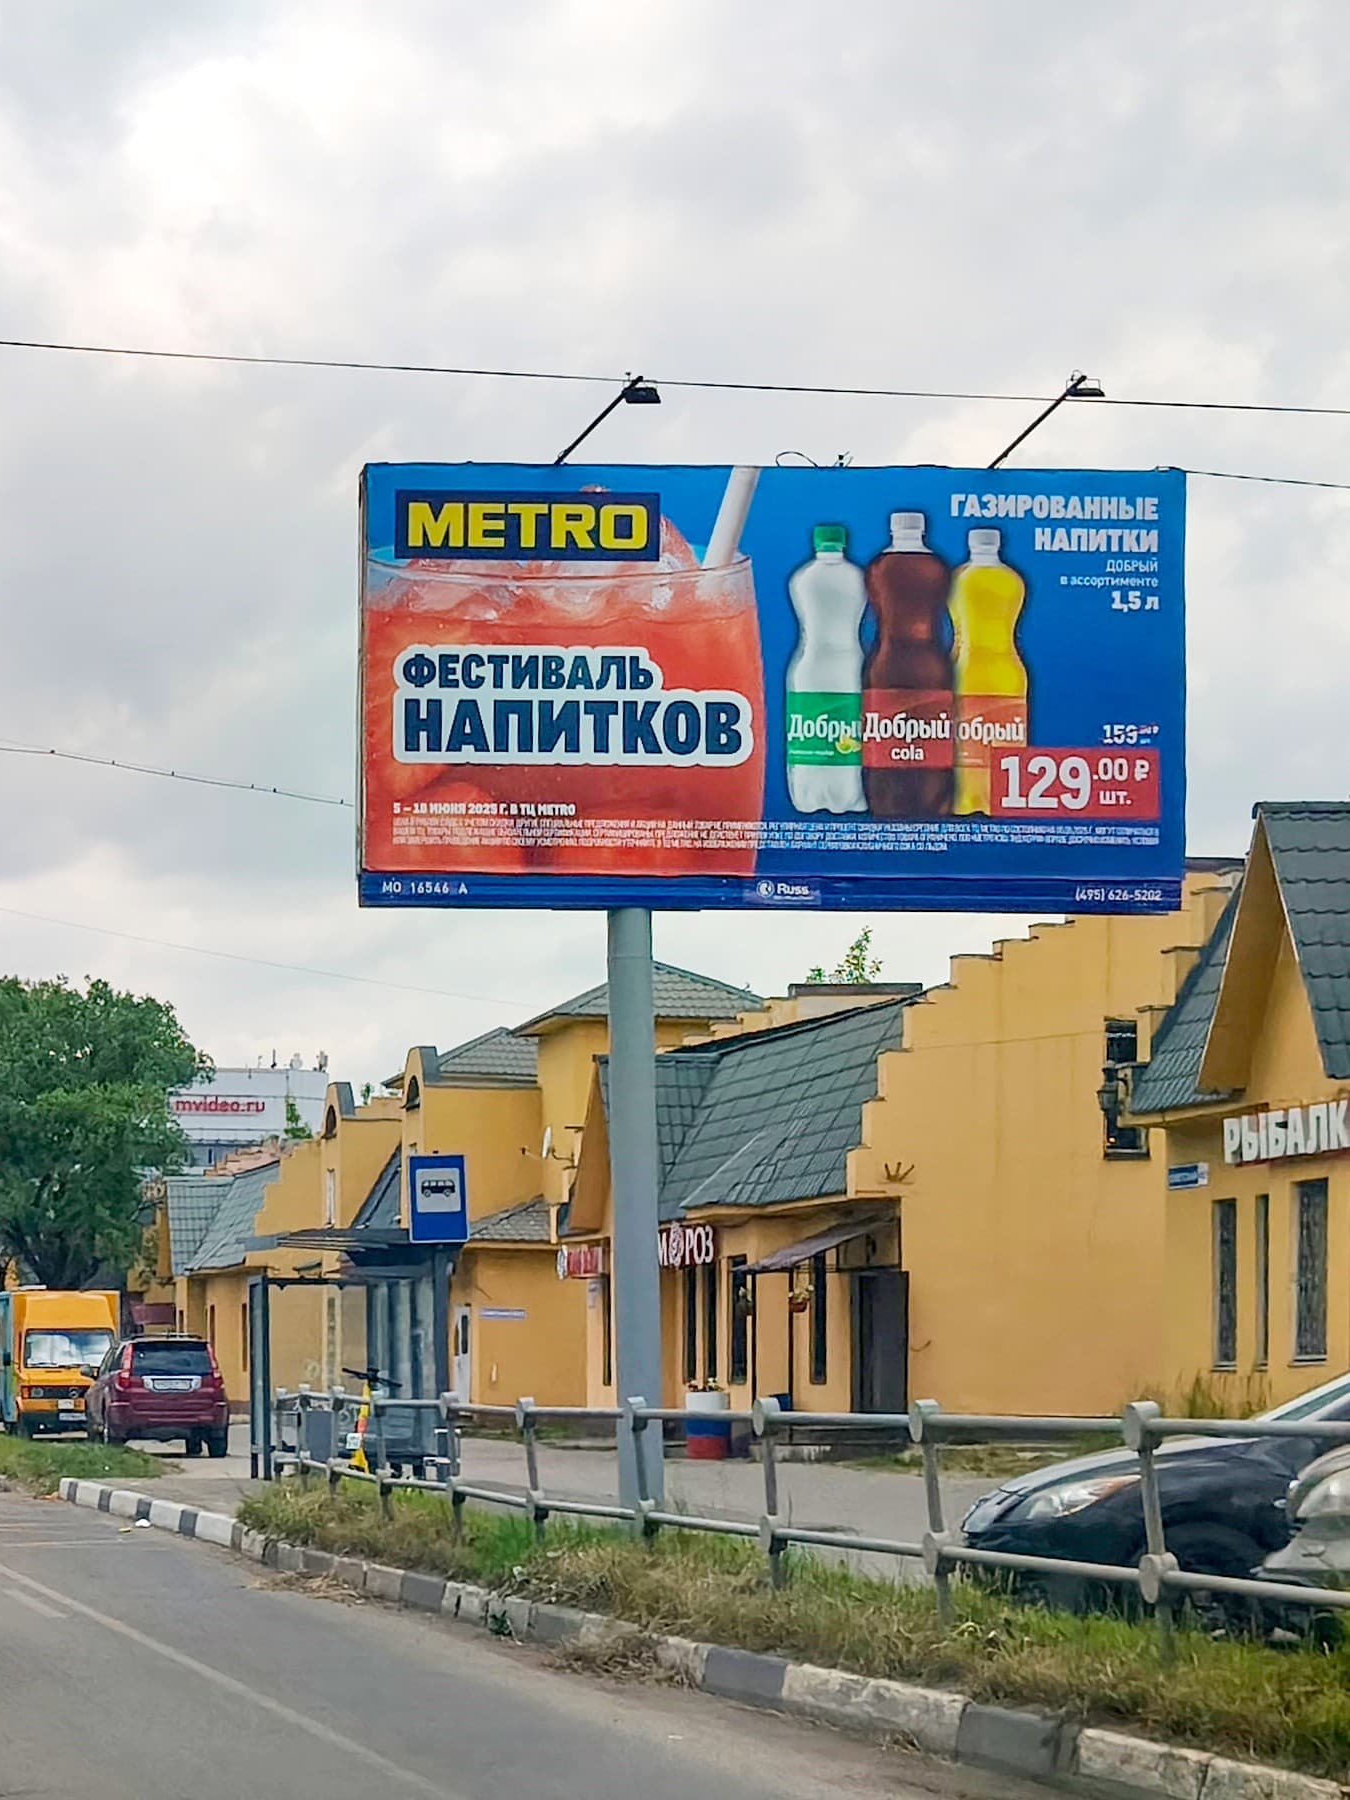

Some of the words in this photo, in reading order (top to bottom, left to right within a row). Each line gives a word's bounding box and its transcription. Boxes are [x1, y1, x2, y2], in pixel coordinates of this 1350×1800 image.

[950, 493, 1159, 521] ГАЗИРОВАННЫЕ
[407, 501, 649, 550] METRO
[1034, 527, 1159, 553] НАПИТКИ
[1105, 557, 1159, 574] ДОБРЫЙ
[1070, 576, 1159, 589] ассортименте
[1111, 590, 1142, 613] 1,5
[1144, 596, 1159, 611] л
[402, 653, 654, 690] ФЕСТИВАЛЬ
[403, 698, 743, 756] НАПИТКОВ
[863, 712, 950, 743] Добрый
[954, 716, 1025, 745] обрый
[890, 744, 925, 761] cola
[468, 803, 497, 815] 2025
[537, 804, 576, 816] METRO
[411, 881, 450, 894] 16546
[776, 883, 810, 896] Russ
[1075, 885, 1105, 902] (495)
[1107, 888, 1162, 901] 626-5202
[175, 1096, 266, 1113] mvideo.ru
